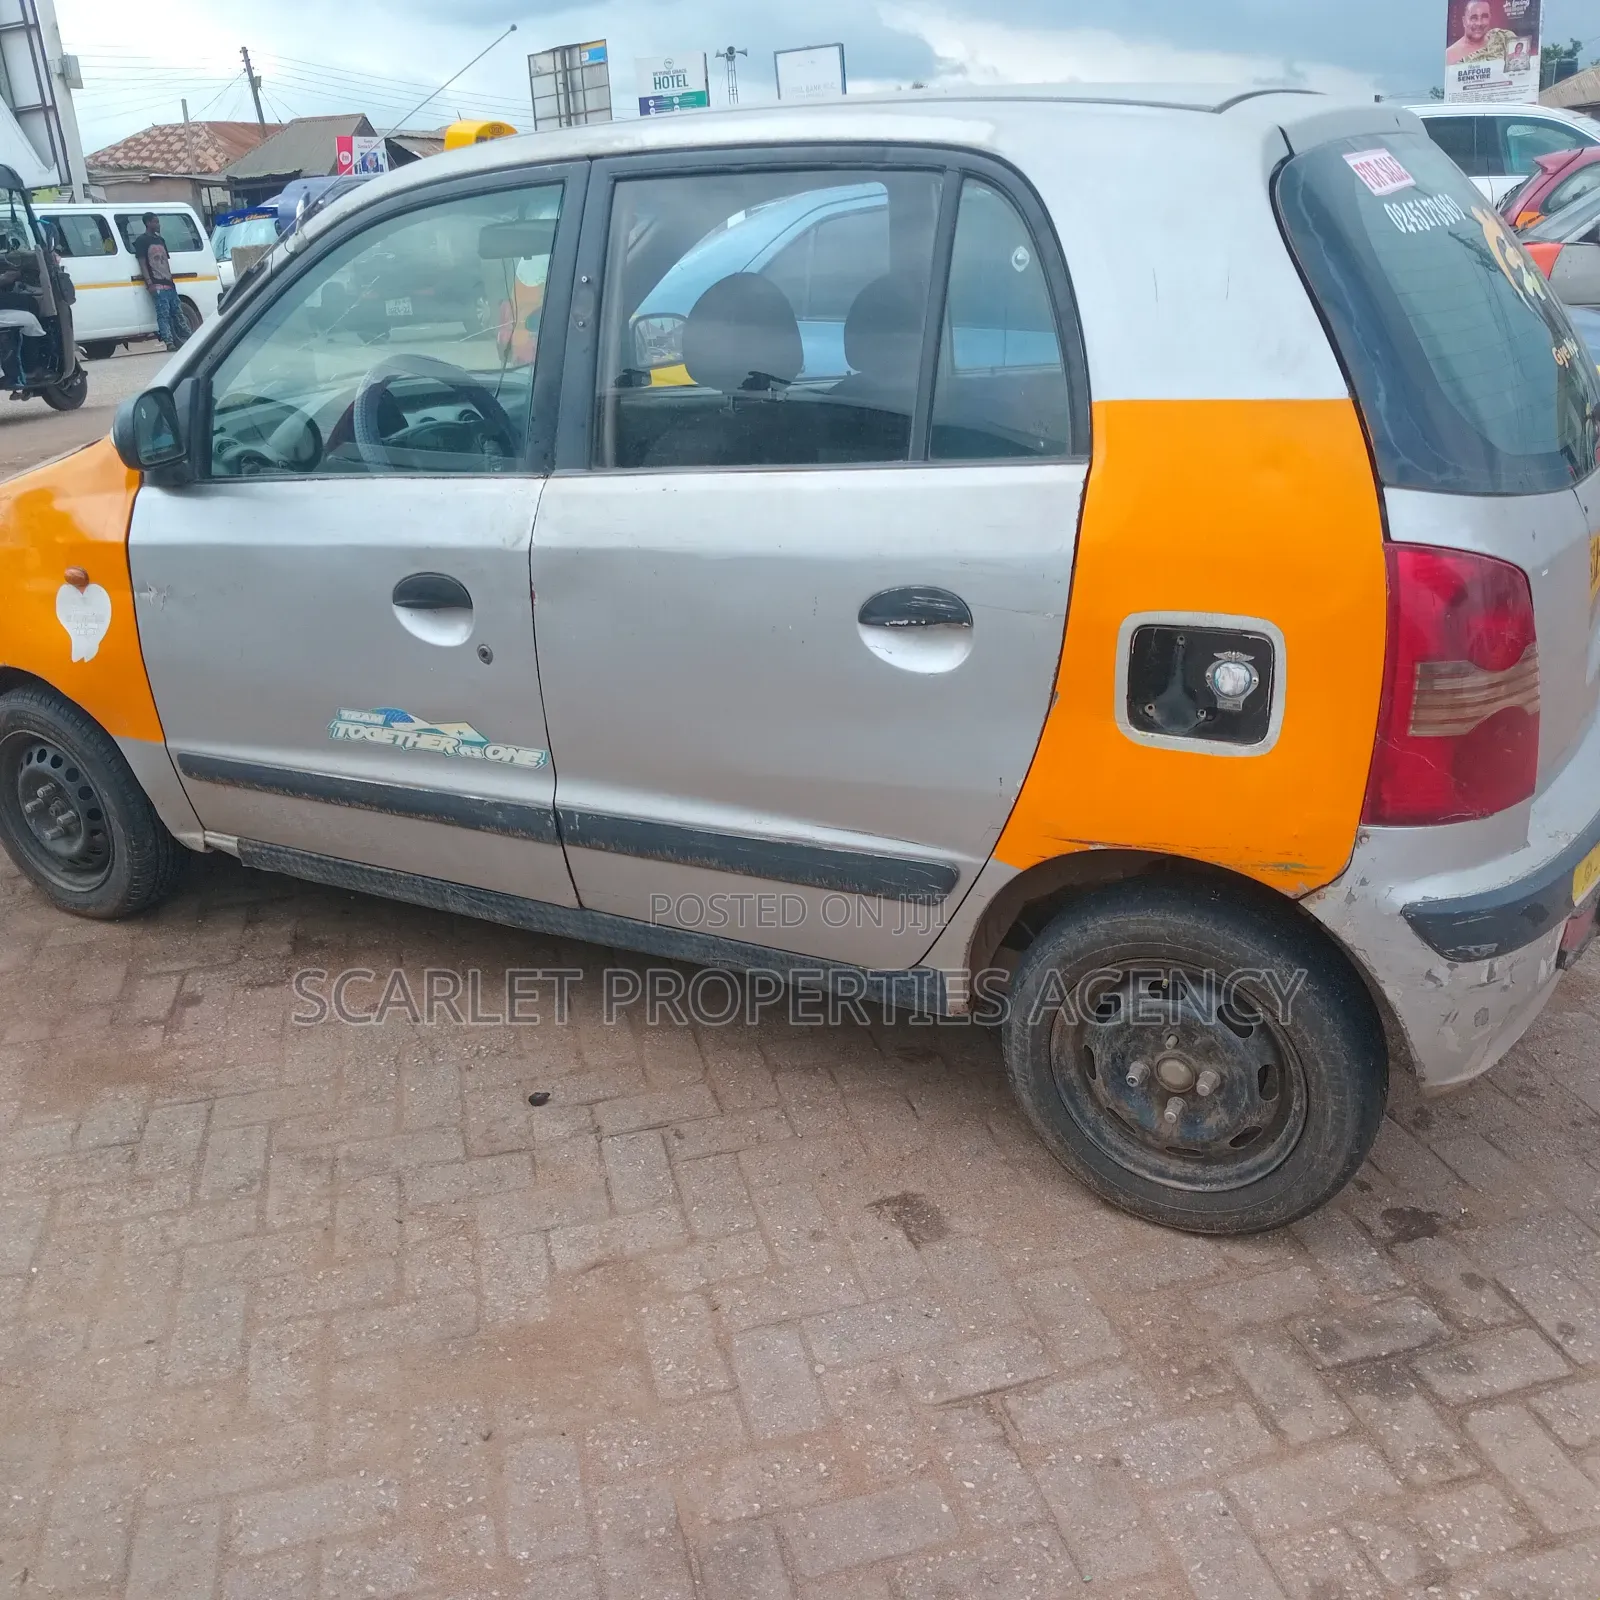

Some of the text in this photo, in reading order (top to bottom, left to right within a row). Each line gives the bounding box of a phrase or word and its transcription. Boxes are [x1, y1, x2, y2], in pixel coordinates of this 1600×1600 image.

[653, 73, 689, 90] HOTEL
[1457, 73, 1491, 82] SENKYIRE
[1458, 67, 1491, 77] BAFFOUR
[1352, 155, 1411, 190] FOR SALE
[1551, 345, 1571, 369] Gye
[332, 722, 459, 755] TOGETHER
[485, 745, 543, 767] ONE
